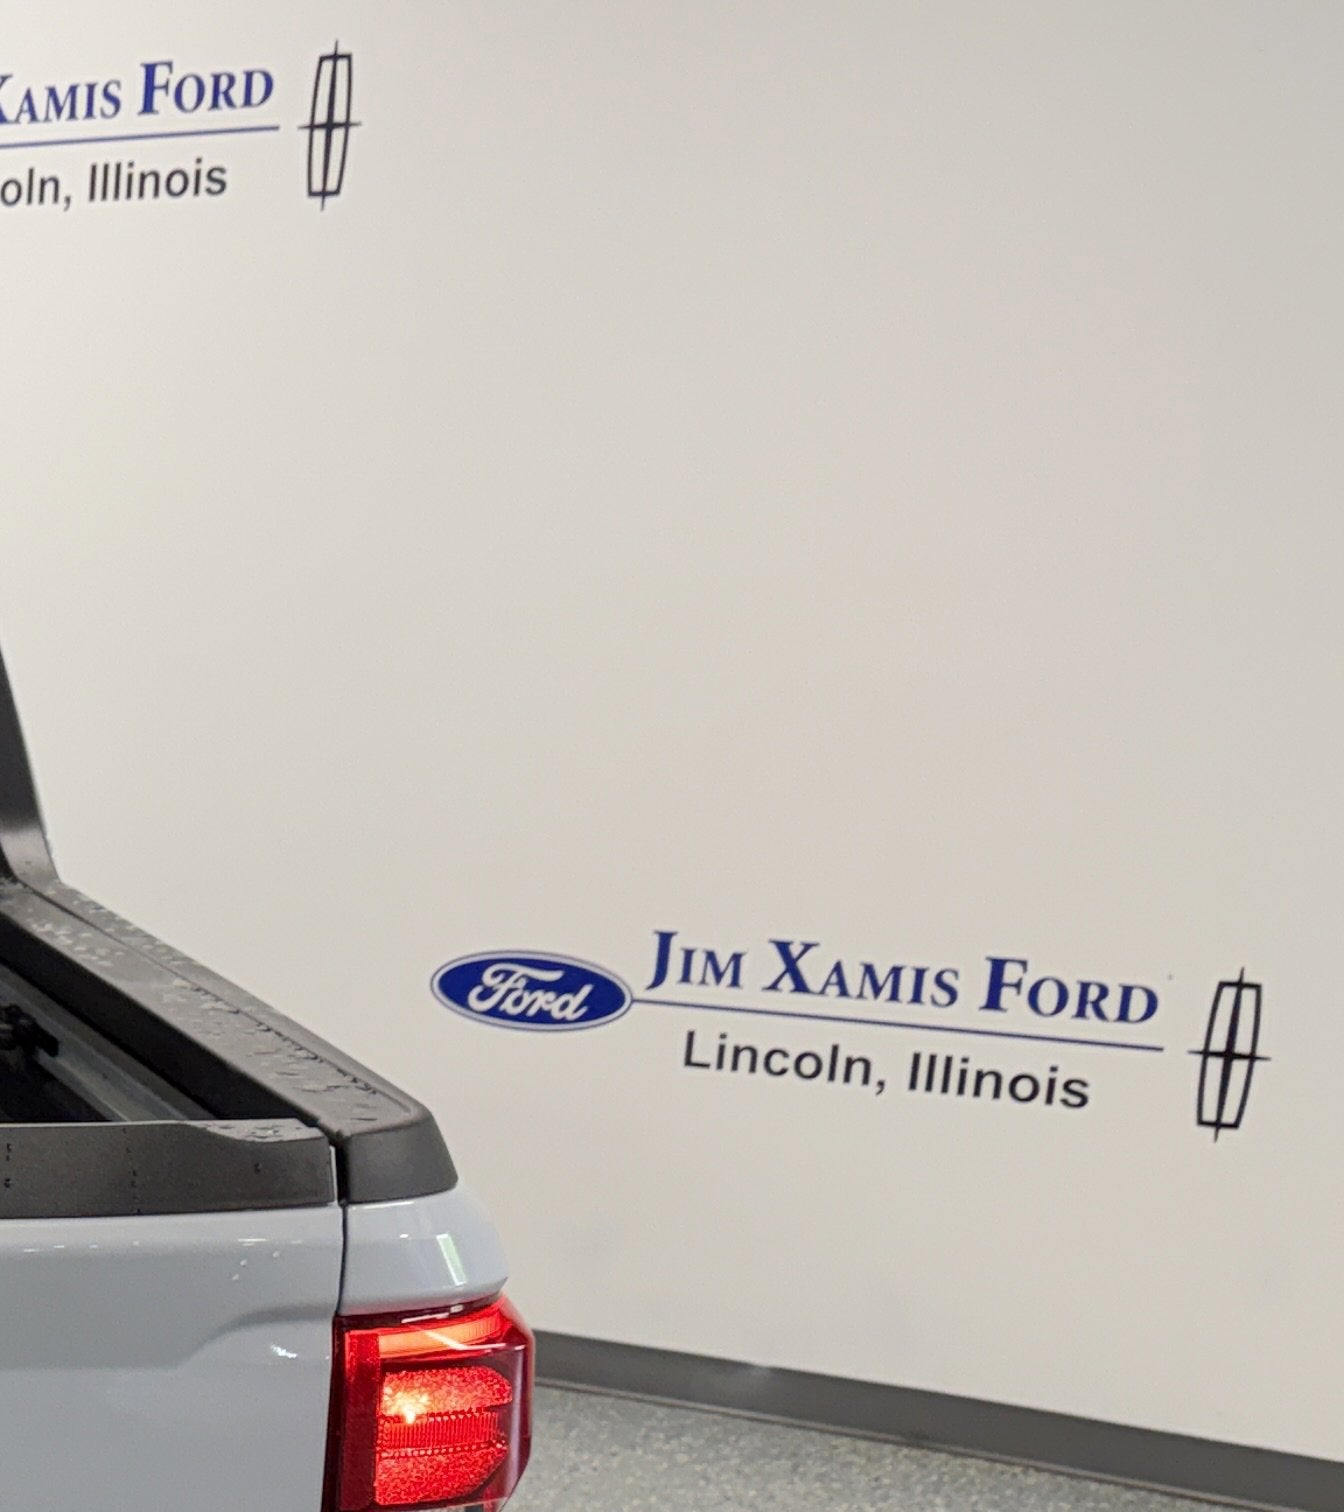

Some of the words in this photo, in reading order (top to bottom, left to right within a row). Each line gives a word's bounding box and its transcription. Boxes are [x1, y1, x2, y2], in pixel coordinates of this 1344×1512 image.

[137, 60, 274, 115] FORD
[87, 157, 228, 204] Illinois
[466, 961, 589, 1023] Ford
[645, 929, 748, 991] JIM
[761, 938, 960, 1009] XAMIS
[979, 955, 1159, 1026] FORD
[683, 1029, 887, 1096] Lincoln,
[908, 1050, 1091, 1110] Illinois
